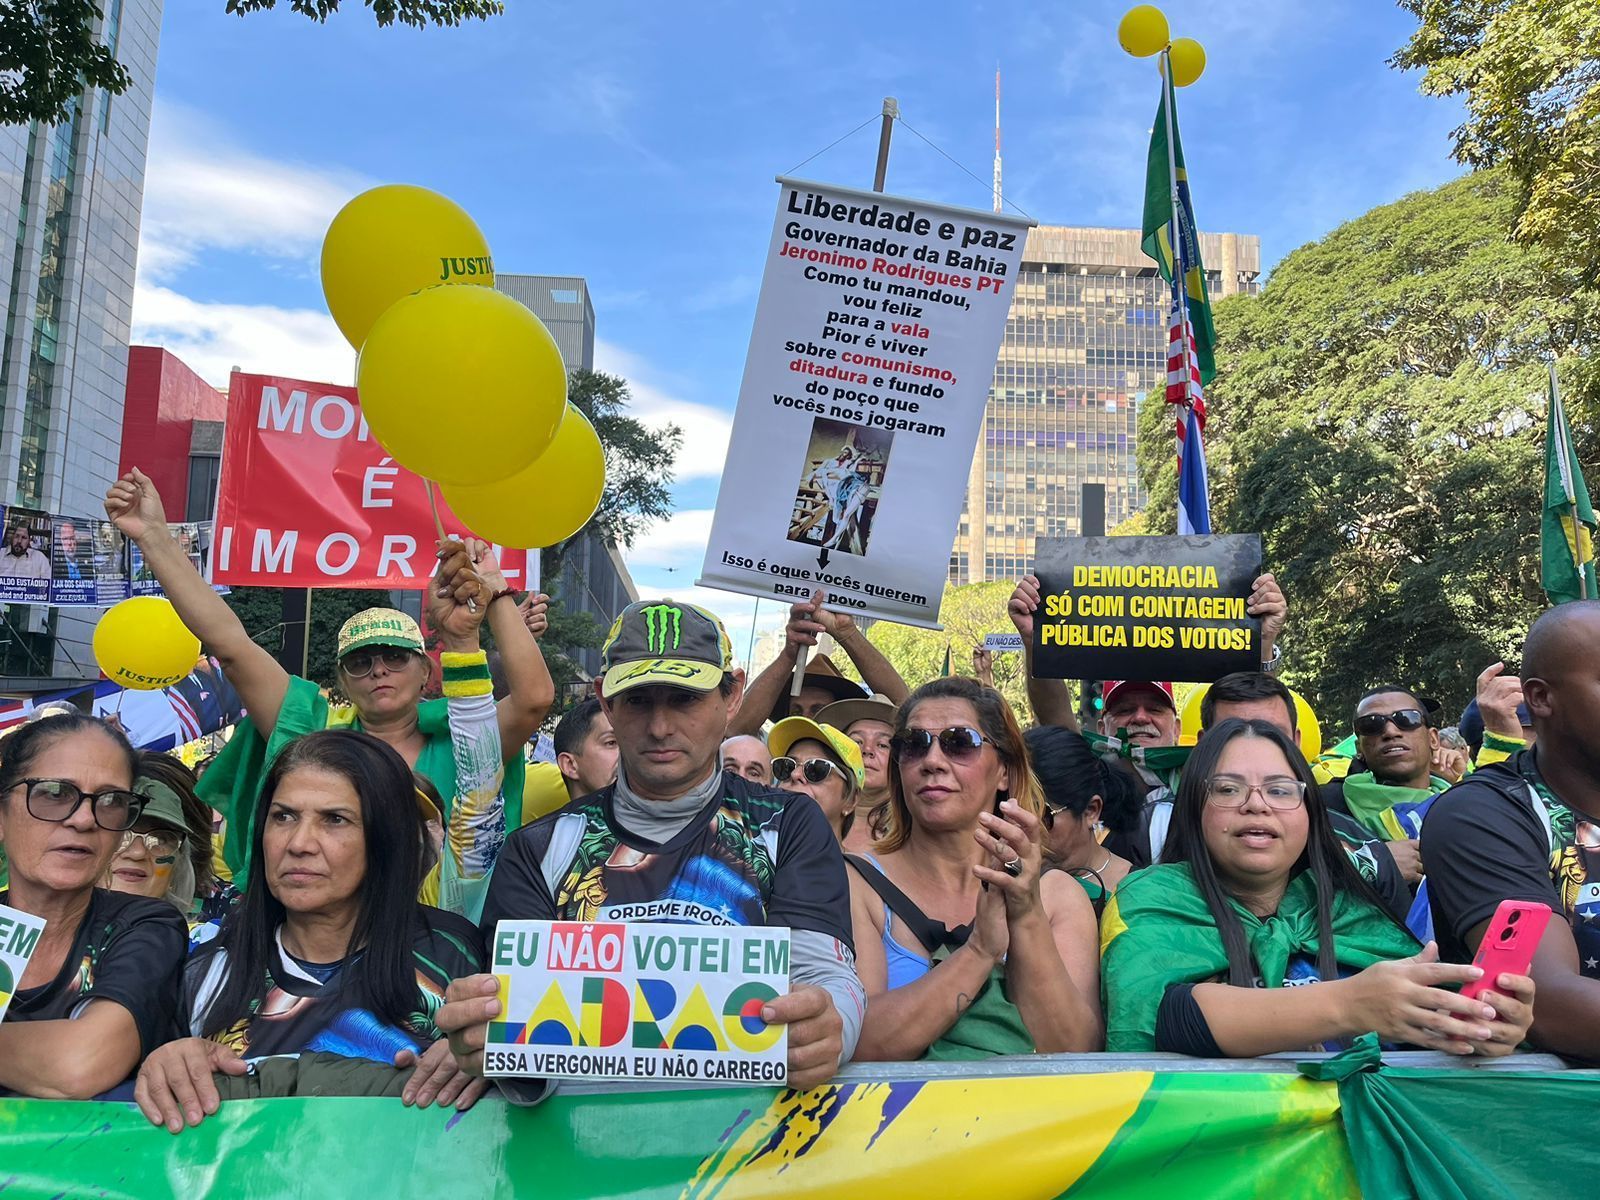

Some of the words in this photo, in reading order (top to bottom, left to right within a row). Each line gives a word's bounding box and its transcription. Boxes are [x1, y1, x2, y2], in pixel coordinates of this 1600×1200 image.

[787, 190, 930, 236] Liberdade
[938, 222, 954, 240] e
[961, 226, 1016, 251] paz
[780, 242, 868, 270] Jeronimo
[872, 258, 971, 289] Rodrigues
[976, 276, 1004, 294] PT
[785, 222, 908, 258] Governador
[914, 246, 940, 264] da
[945, 250, 1008, 276] Bahia
[804, 266, 858, 288] Como
[863, 276, 882, 292] tu
[886, 283, 970, 311] mandou,
[843, 294, 876, 310] vou
[882, 300, 922, 318] feliz
[822, 326, 861, 346] Pior
[864, 334, 876, 348] é
[881, 338, 928, 358] viver
[826, 310, 869, 328] para
[874, 318, 886, 331] a
[890, 322, 930, 339] vala
[784, 340, 836, 360] sobre
[841, 352, 957, 386] comunismo,
[789, 358, 868, 385] ditadura
[873, 376, 884, 388] e
[888, 377, 944, 399] fundo
[773, 394, 825, 414] vocês
[830, 406, 864, 422] nos
[866, 410, 946, 438] jogaram
[805, 380, 829, 396] do
[833, 386, 880, 406] poço
[884, 397, 920, 414] que
[362, 458, 398, 508] É
[219, 526, 520, 578] IMORL
[75, 580, 94, 588] SANTOS
[722, 550, 754, 568] Isso
[757, 559, 766, 571] é
[770, 564, 811, 580] oque
[814, 571, 860, 591] vocês
[864, 582, 927, 605] querem
[774, 582, 810, 598] para
[828, 593, 867, 610] povo
[1073, 566, 1218, 588] DEMOCRACIA
[1045, 591, 1074, 617] SÓ
[1078, 595, 1125, 617] COM
[1130, 596, 1244, 620] CONTAGEM
[1042, 620, 1126, 647] PÚBLICA
[1133, 626, 1174, 648] DOS
[1178, 627, 1251, 650] VOTOS!
[494, 931, 539, 967] EU
[552, 925, 622, 970] NÃO
[632, 935, 729, 974] VOTEI
[742, 938, 788, 975] EM
[485, 1052, 528, 1073] ESSA
[534, 1054, 628, 1076] VERGONHA
[633, 1056, 656, 1076] EU
[663, 1054, 698, 1078] NÃO
[704, 1059, 786, 1080] CARREGO
